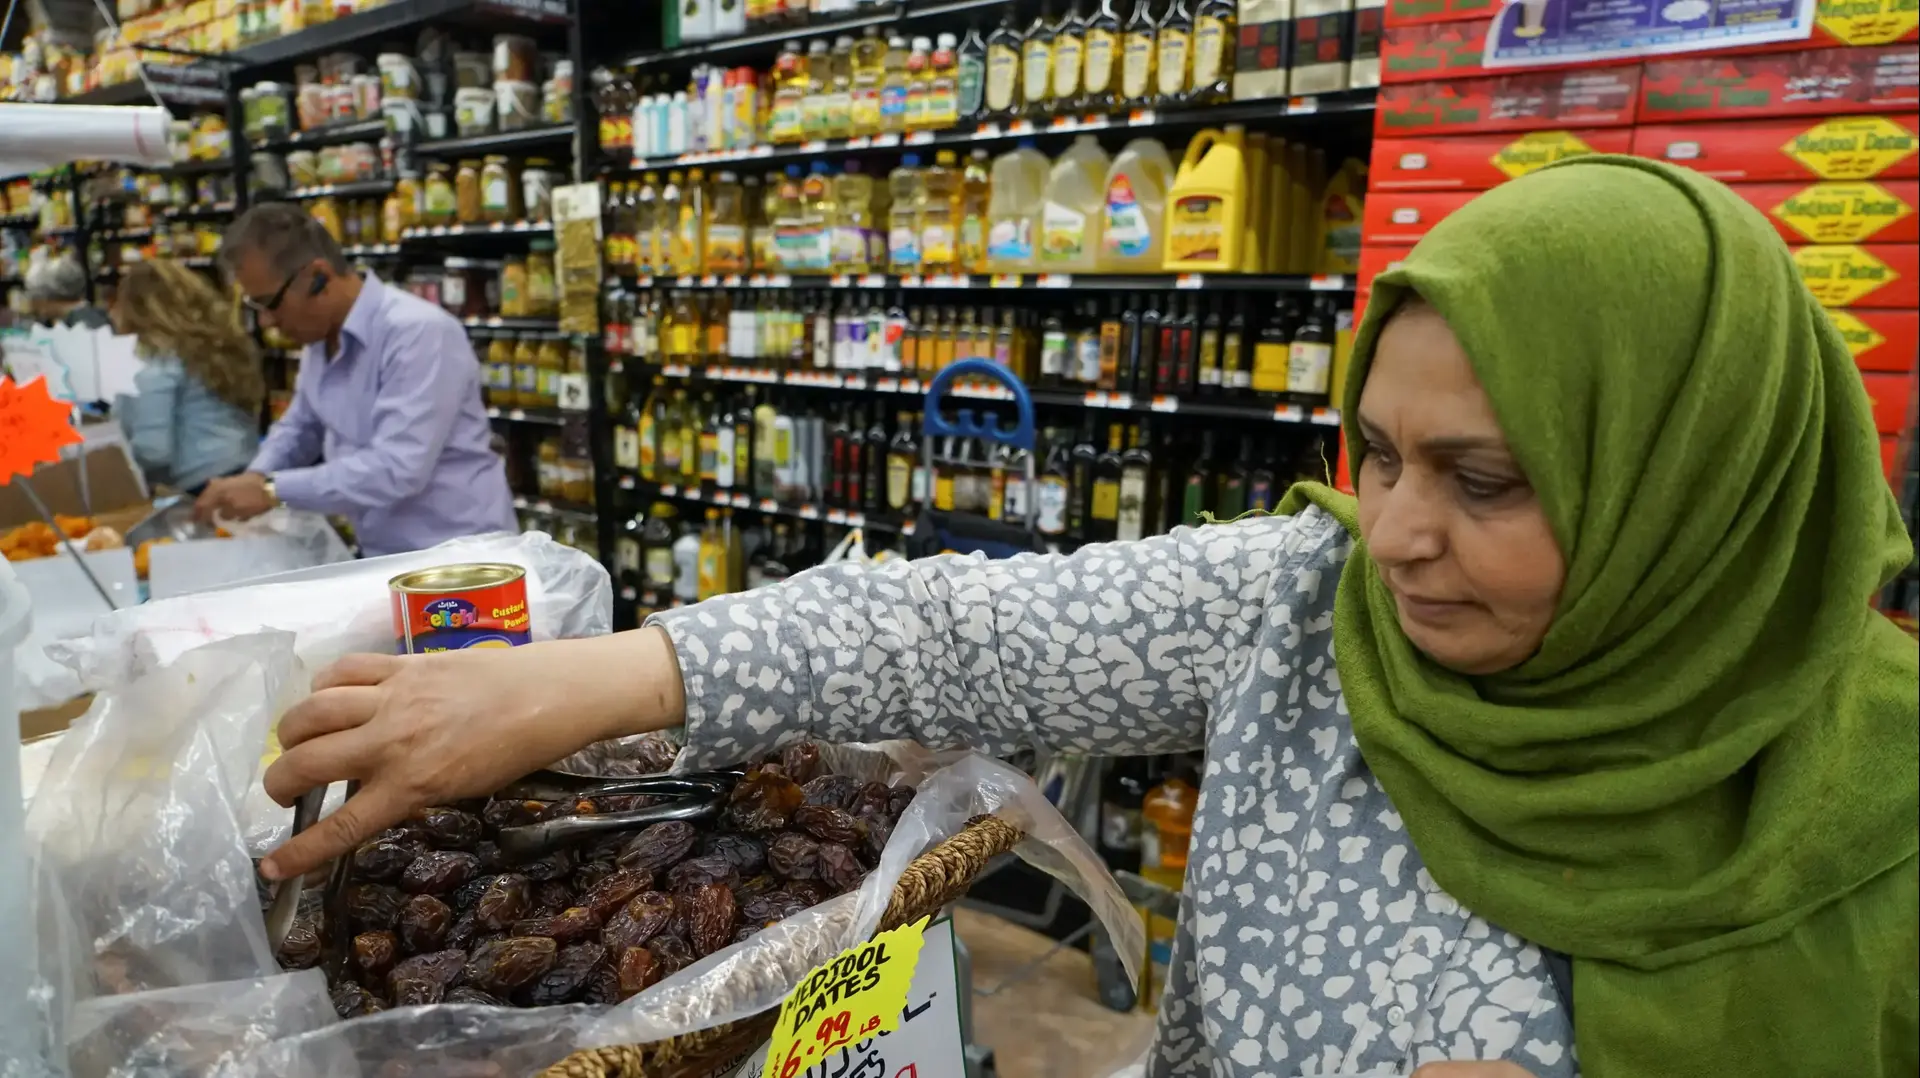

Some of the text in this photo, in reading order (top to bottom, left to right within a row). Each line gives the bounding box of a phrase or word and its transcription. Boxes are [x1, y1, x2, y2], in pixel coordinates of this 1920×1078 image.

[420, 608, 480, 628] Delight
[491, 599, 525, 619] Custard
[503, 612, 529, 629] Powde
[782, 942, 891, 1026] MEDJOOL
[791, 966, 881, 1037] DATES
[859, 1015, 881, 1036] LB
